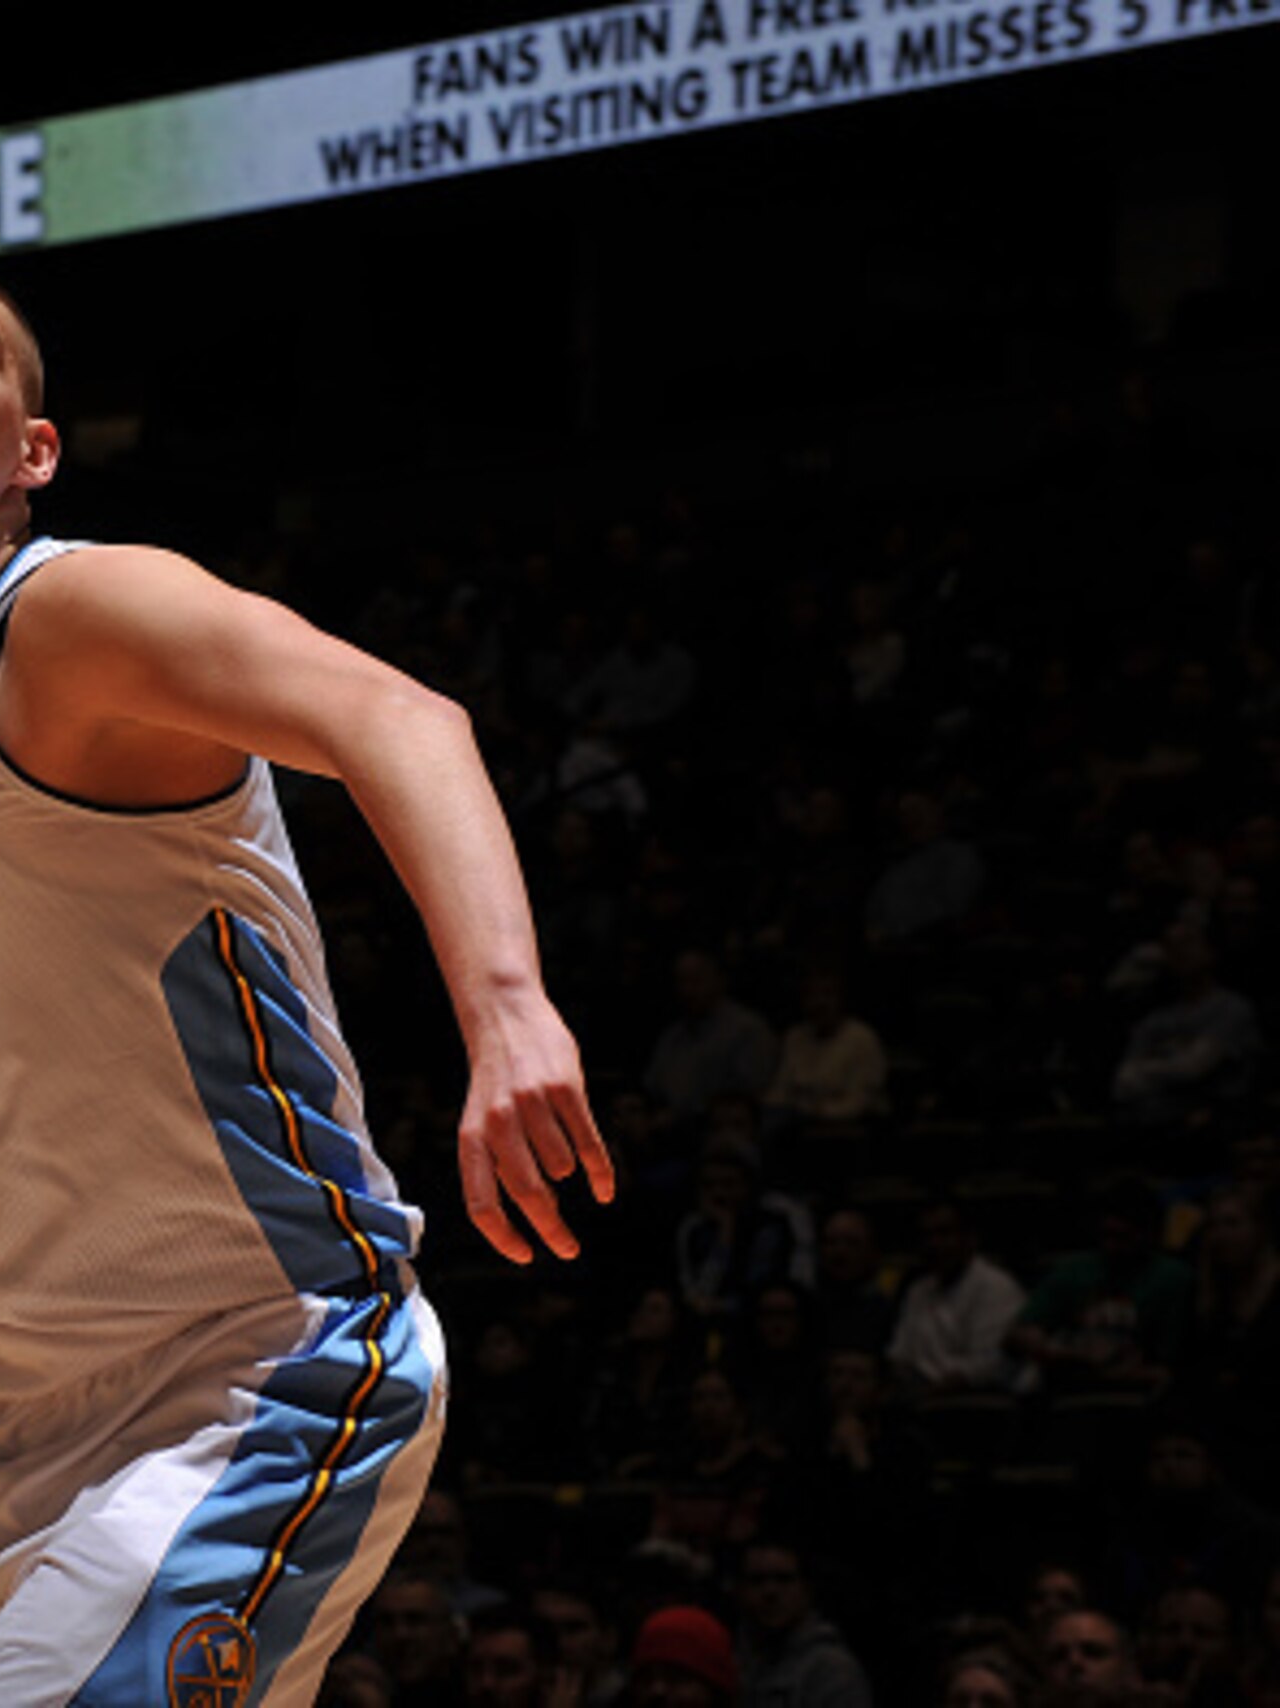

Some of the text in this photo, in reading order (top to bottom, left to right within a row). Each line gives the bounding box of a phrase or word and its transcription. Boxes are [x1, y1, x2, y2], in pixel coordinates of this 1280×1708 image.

[320, 115, 468, 184] WHEN
[489, 70, 708, 151] VISITING
[729, 40, 870, 109] TEAM
[895, 0, 1090, 80] MISSES
[415, 36, 538, 101] FANS
[562, 9, 668, 72] WIN
[692, 0, 725, 49] A
